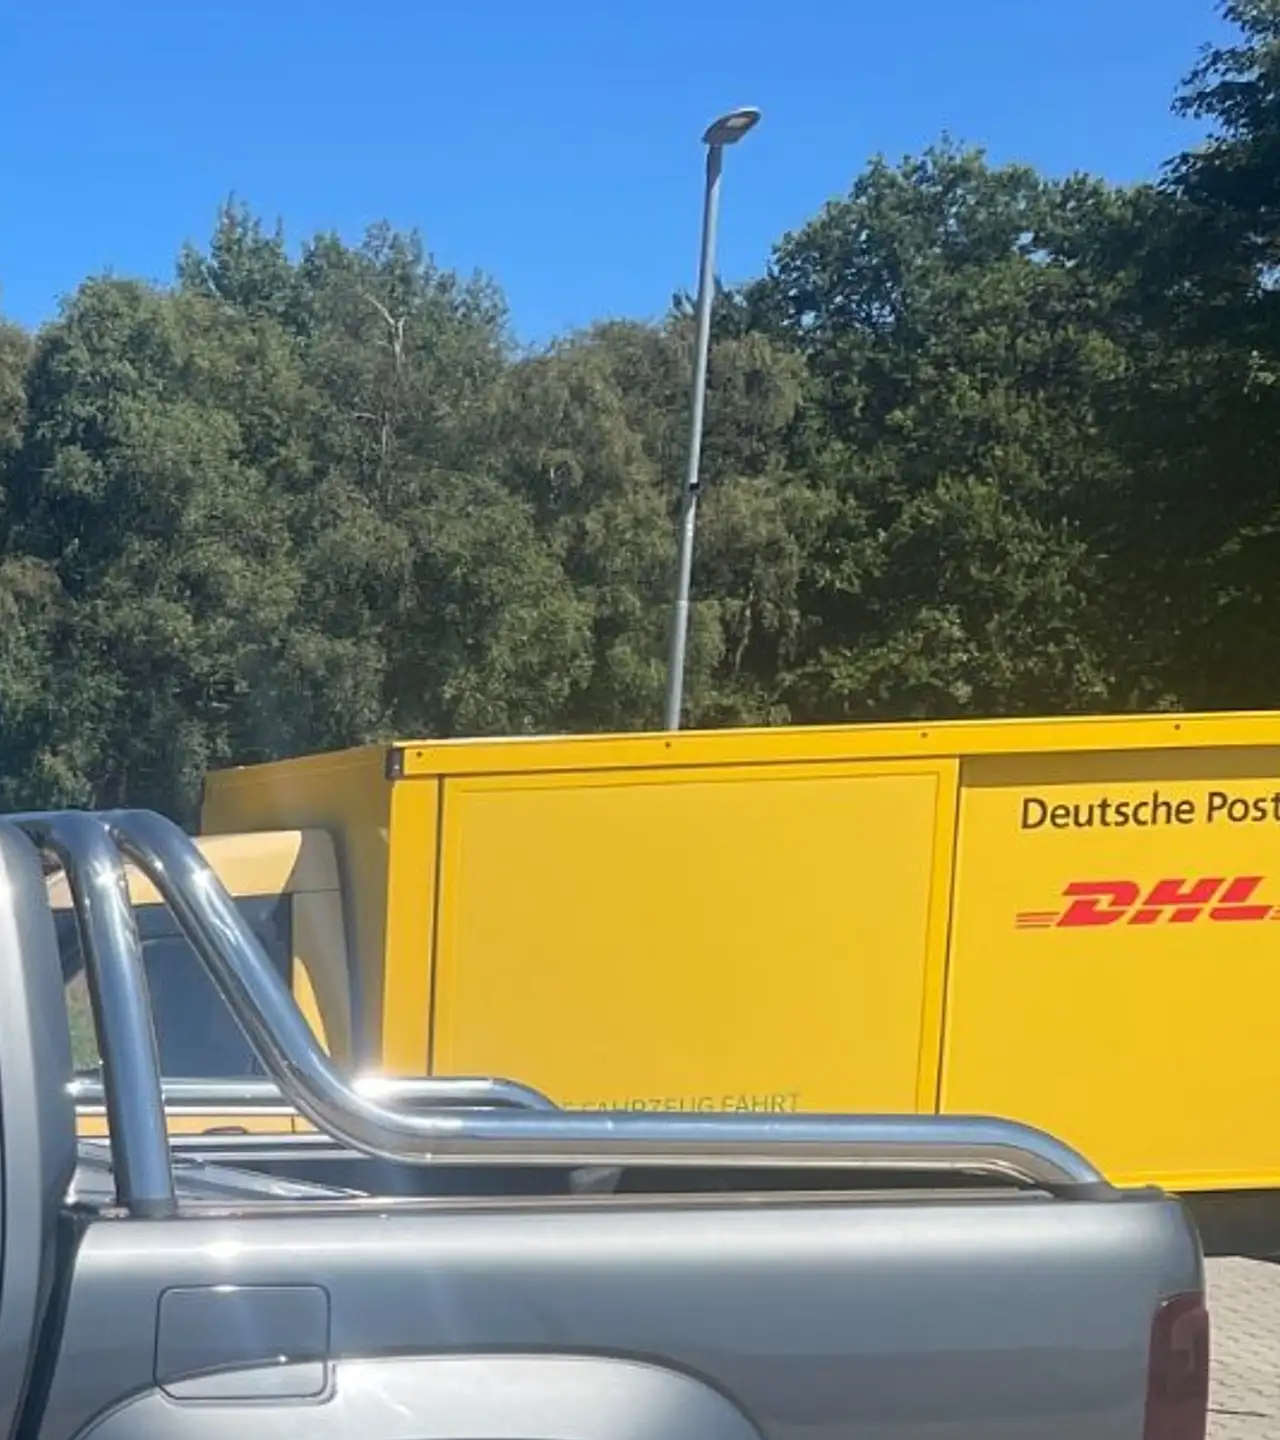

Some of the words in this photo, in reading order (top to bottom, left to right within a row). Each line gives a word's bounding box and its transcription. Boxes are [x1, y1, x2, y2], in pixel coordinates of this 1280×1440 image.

[1020, 790, 1195, 830] Deutsche
[1207, 791, 1280, 824] Post
[1054, 875, 1274, 928] DHL
